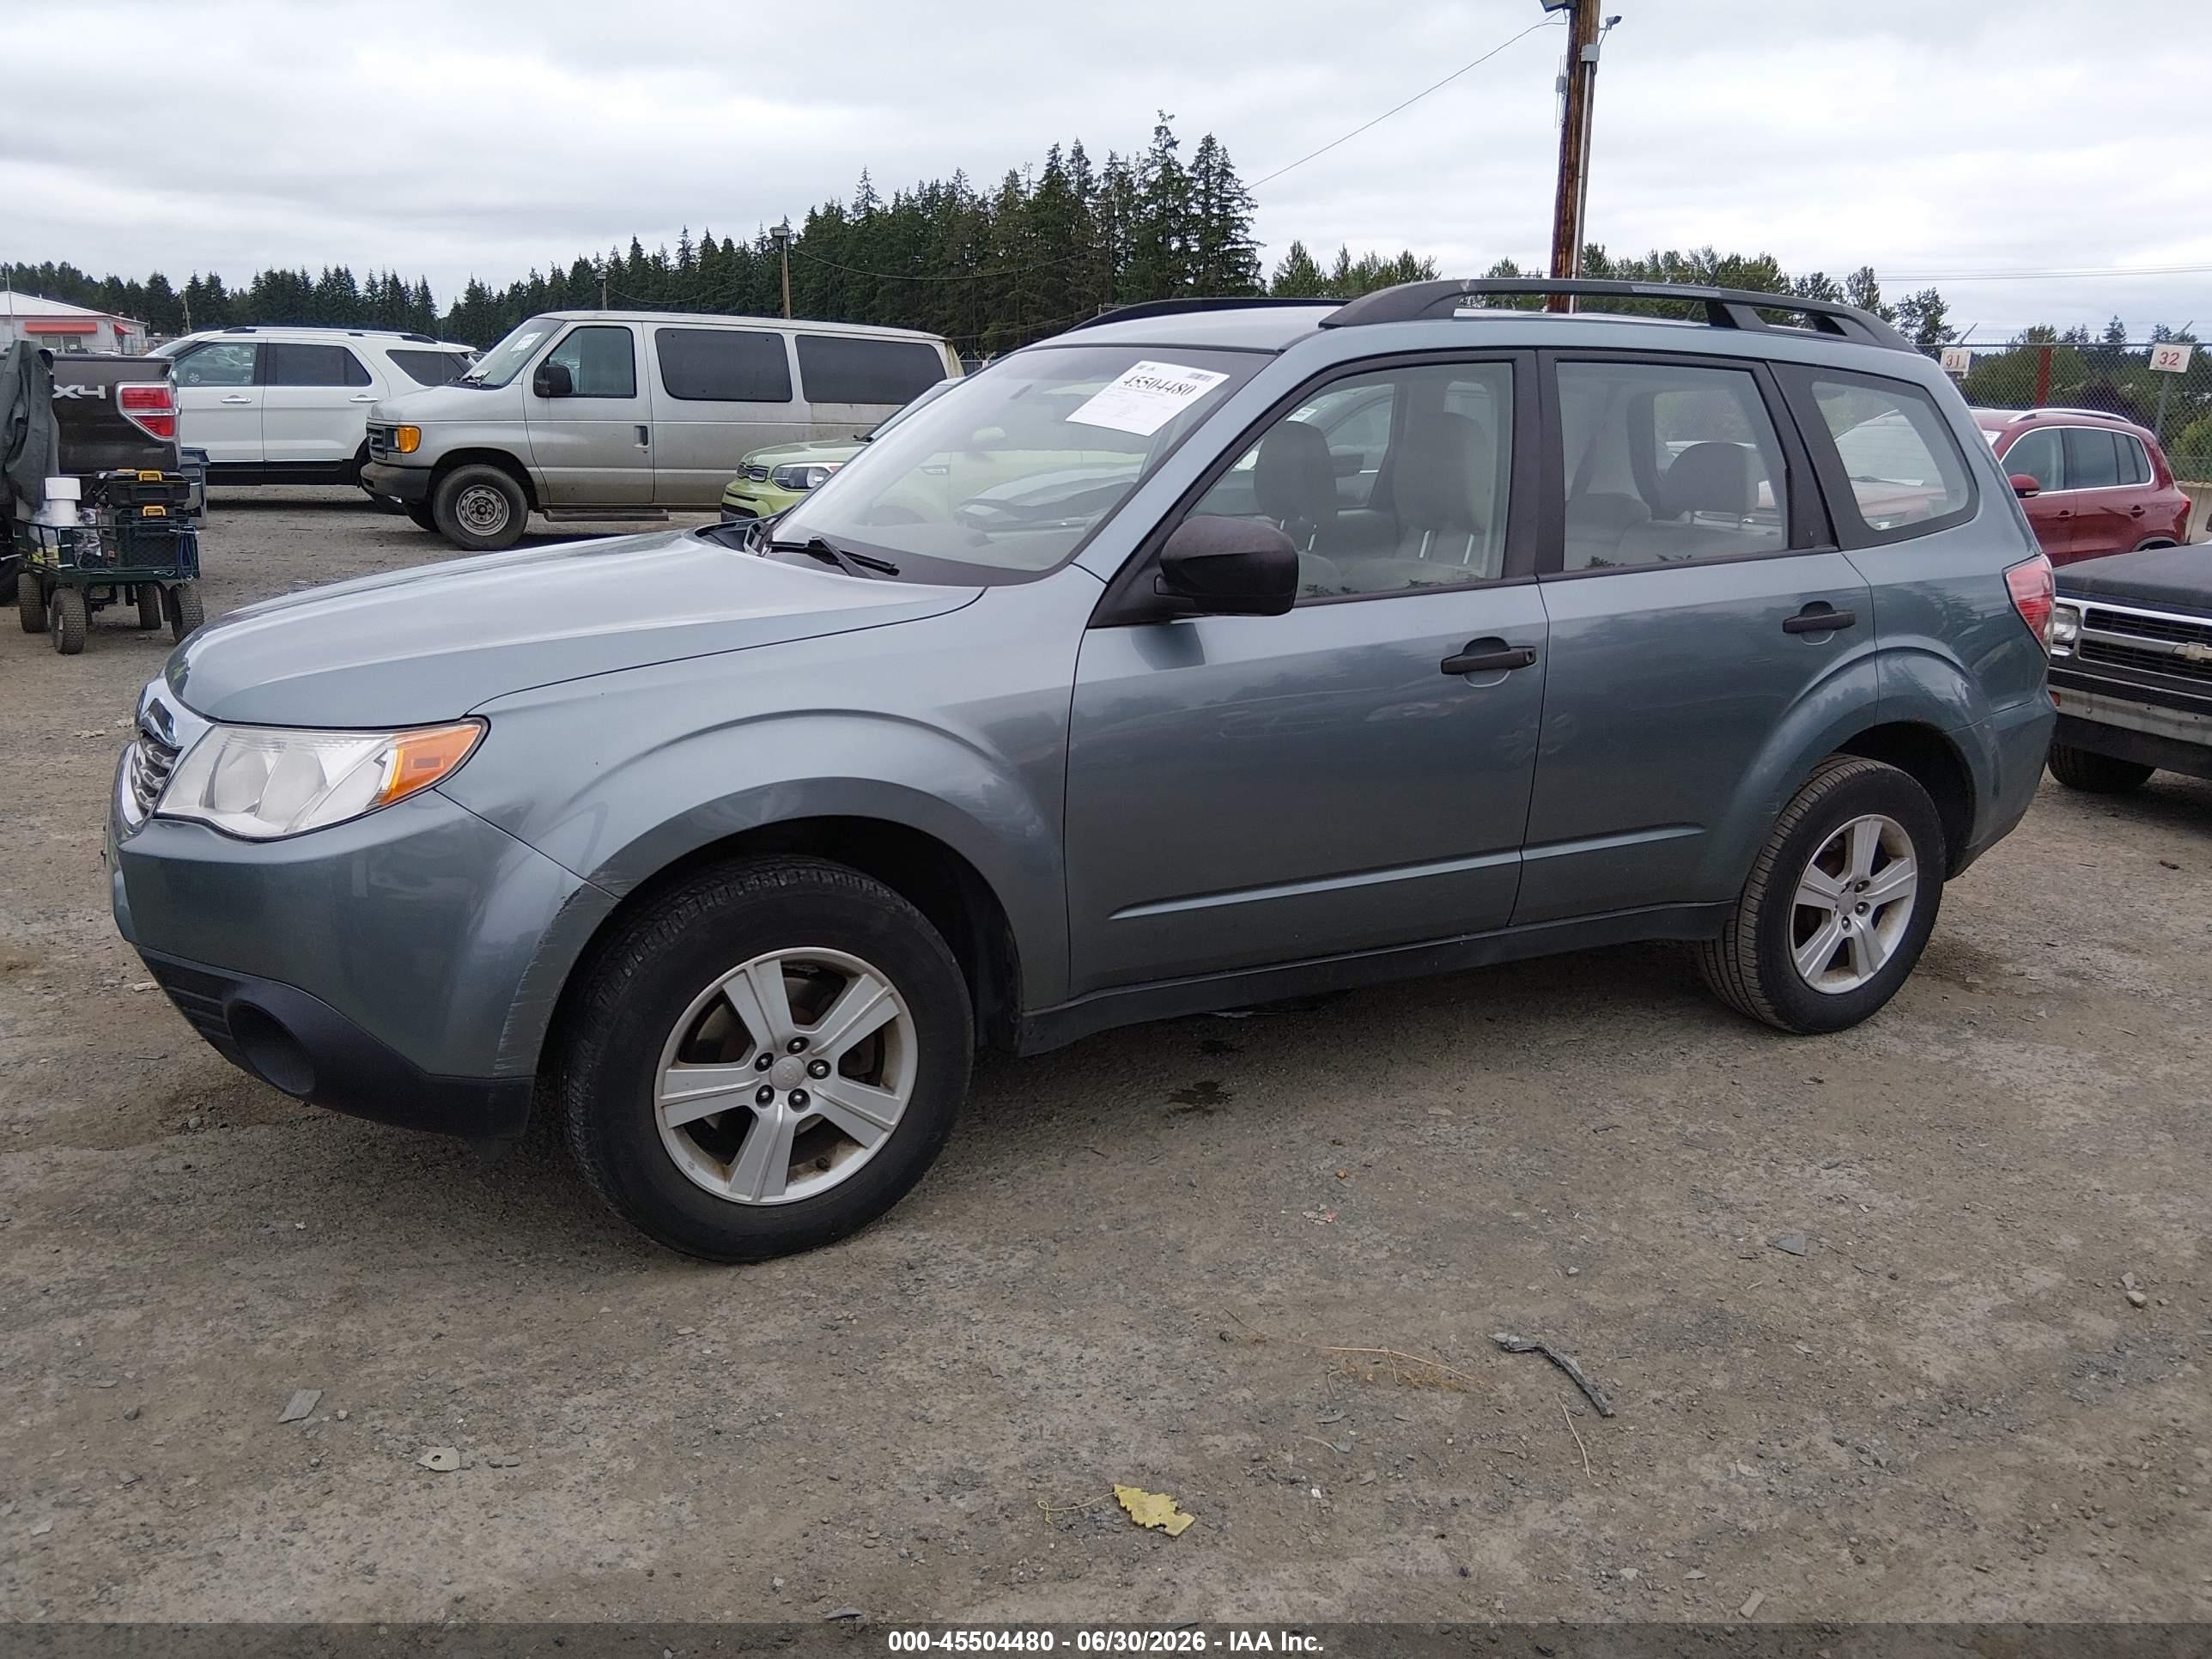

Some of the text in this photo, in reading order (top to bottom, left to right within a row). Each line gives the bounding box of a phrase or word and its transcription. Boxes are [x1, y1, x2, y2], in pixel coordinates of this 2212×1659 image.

[1947, 355, 1960, 367] 31
[2160, 351, 2179, 365] 32
[52, 384, 106, 399] X4
[1123, 375, 1197, 396] 45504480
